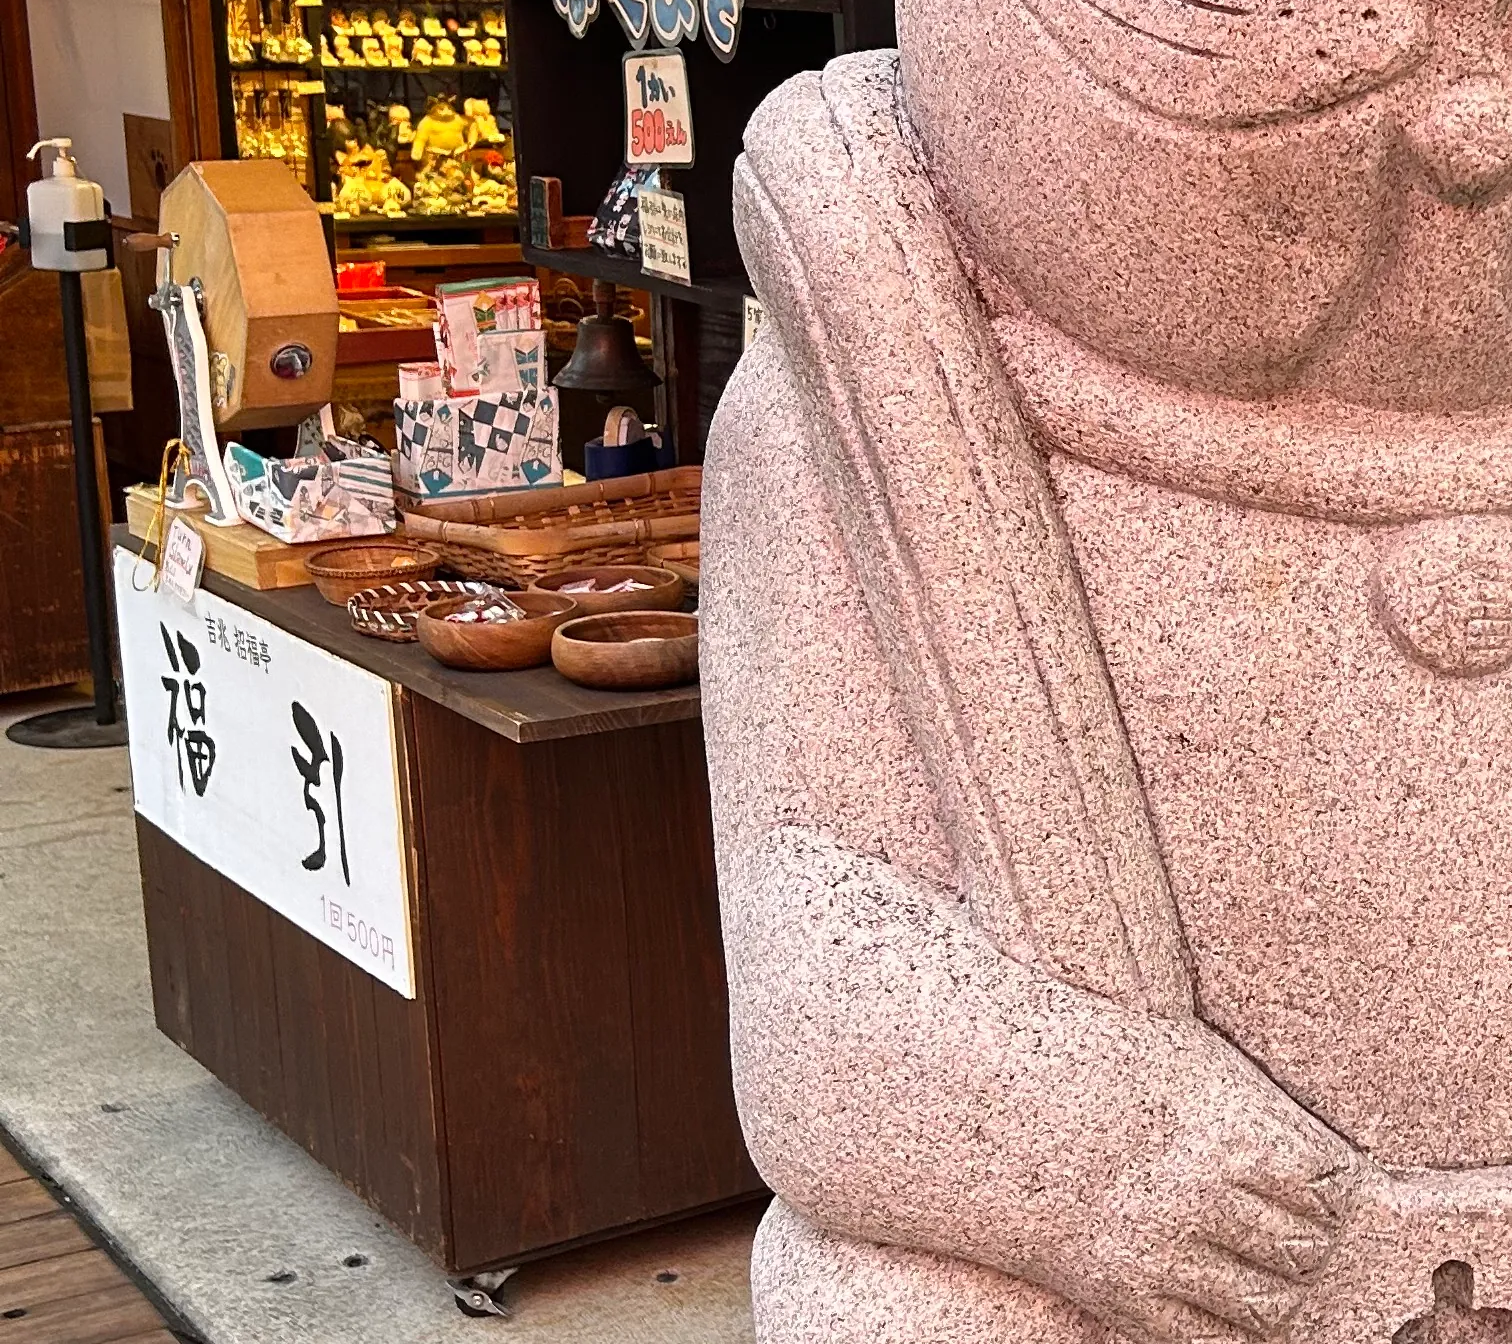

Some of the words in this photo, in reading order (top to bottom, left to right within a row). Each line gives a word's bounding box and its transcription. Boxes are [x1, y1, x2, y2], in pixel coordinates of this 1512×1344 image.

[636, 65, 676, 108] 1かい
[631, 108, 687, 156] 500えん
[204, 611, 232, 653] 吉兆
[233, 624, 272, 675] 招福亭
[320, 894, 395, 971] 1回500円
